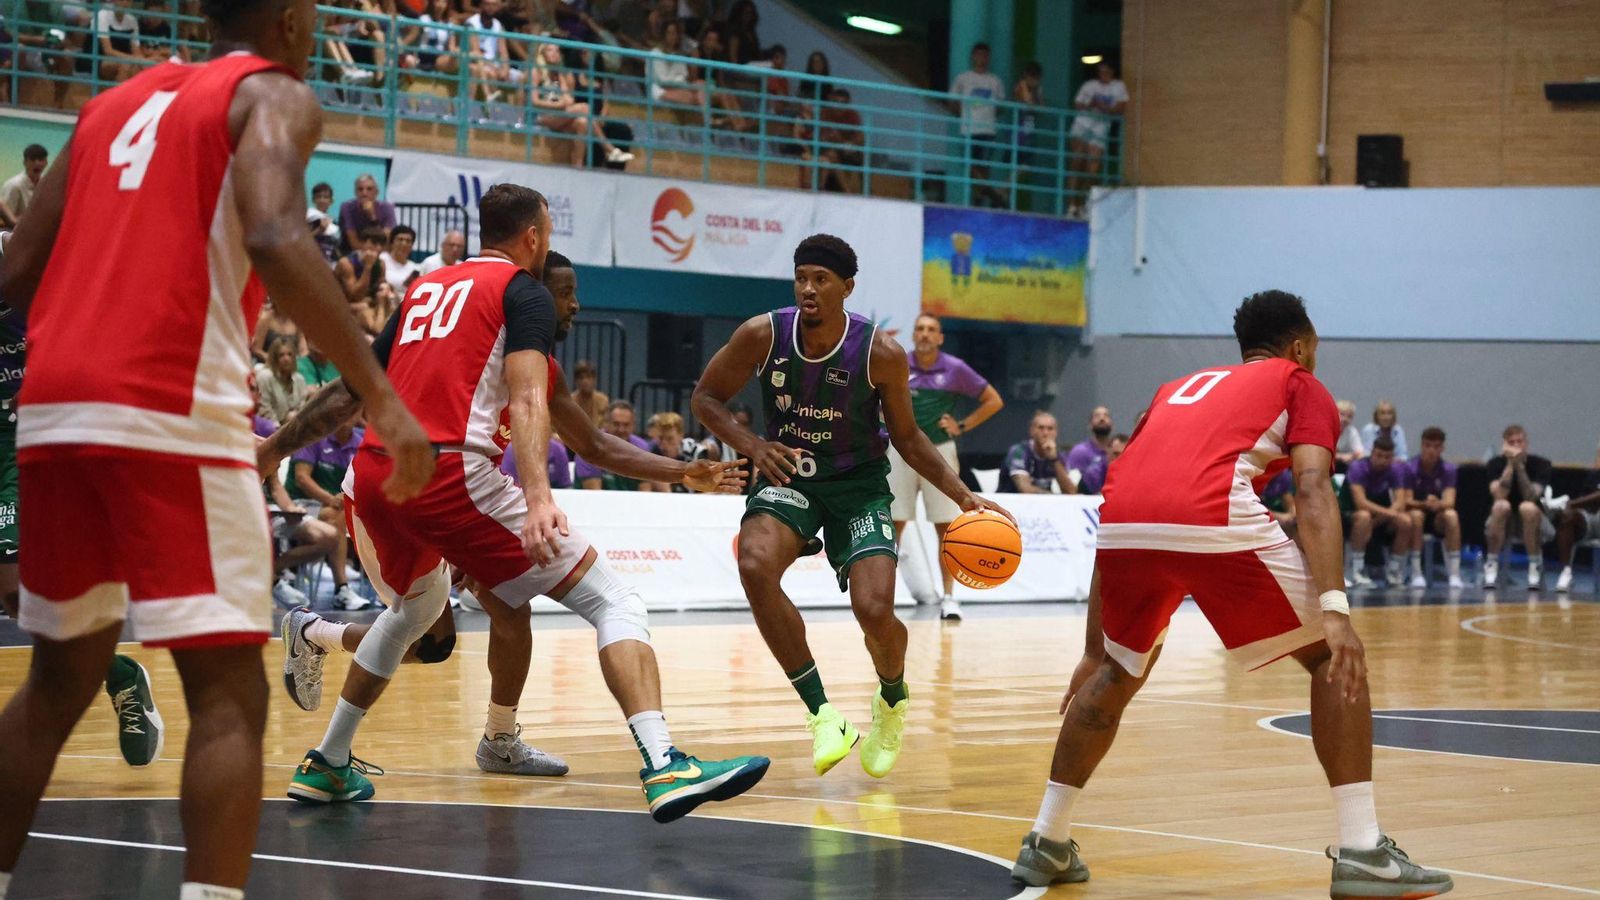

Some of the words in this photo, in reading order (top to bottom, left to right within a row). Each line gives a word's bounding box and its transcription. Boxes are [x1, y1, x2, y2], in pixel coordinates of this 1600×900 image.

[109, 90, 178, 190] 4
[705, 214, 740, 228] COSTA
[742, 217, 761, 232] DEL
[764, 220, 783, 234] SOL
[399, 278, 474, 346] 20
[1167, 370, 1232, 404] 0
[792, 403, 842, 421] Unicaja
[606, 550, 640, 561] COSTA
[641, 550, 661, 561] DEL
[661, 550, 683, 561] SOL
[978, 558, 1000, 570] acb
